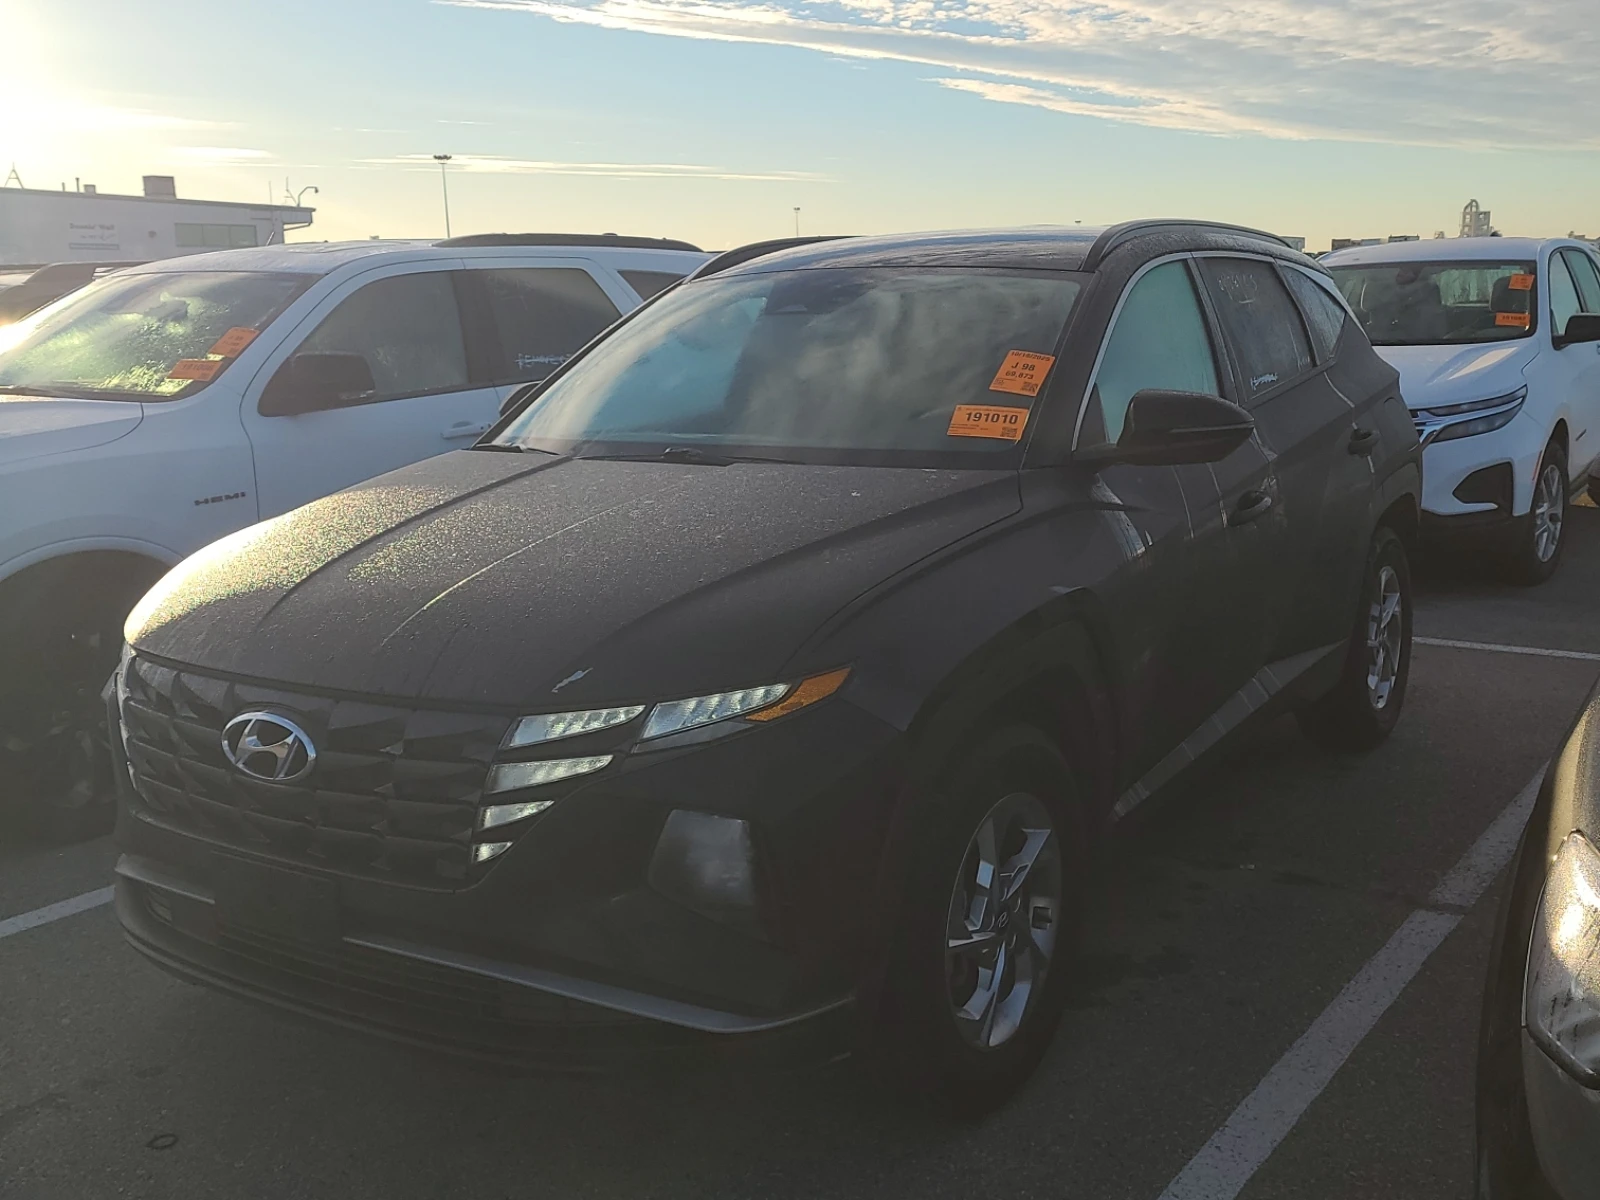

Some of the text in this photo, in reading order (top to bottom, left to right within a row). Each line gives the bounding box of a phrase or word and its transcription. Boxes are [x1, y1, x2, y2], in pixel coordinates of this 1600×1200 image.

[1011, 361, 1036, 371] J 98
[966, 412, 1019, 424] 191010
[194, 491, 246, 506] HEMI
